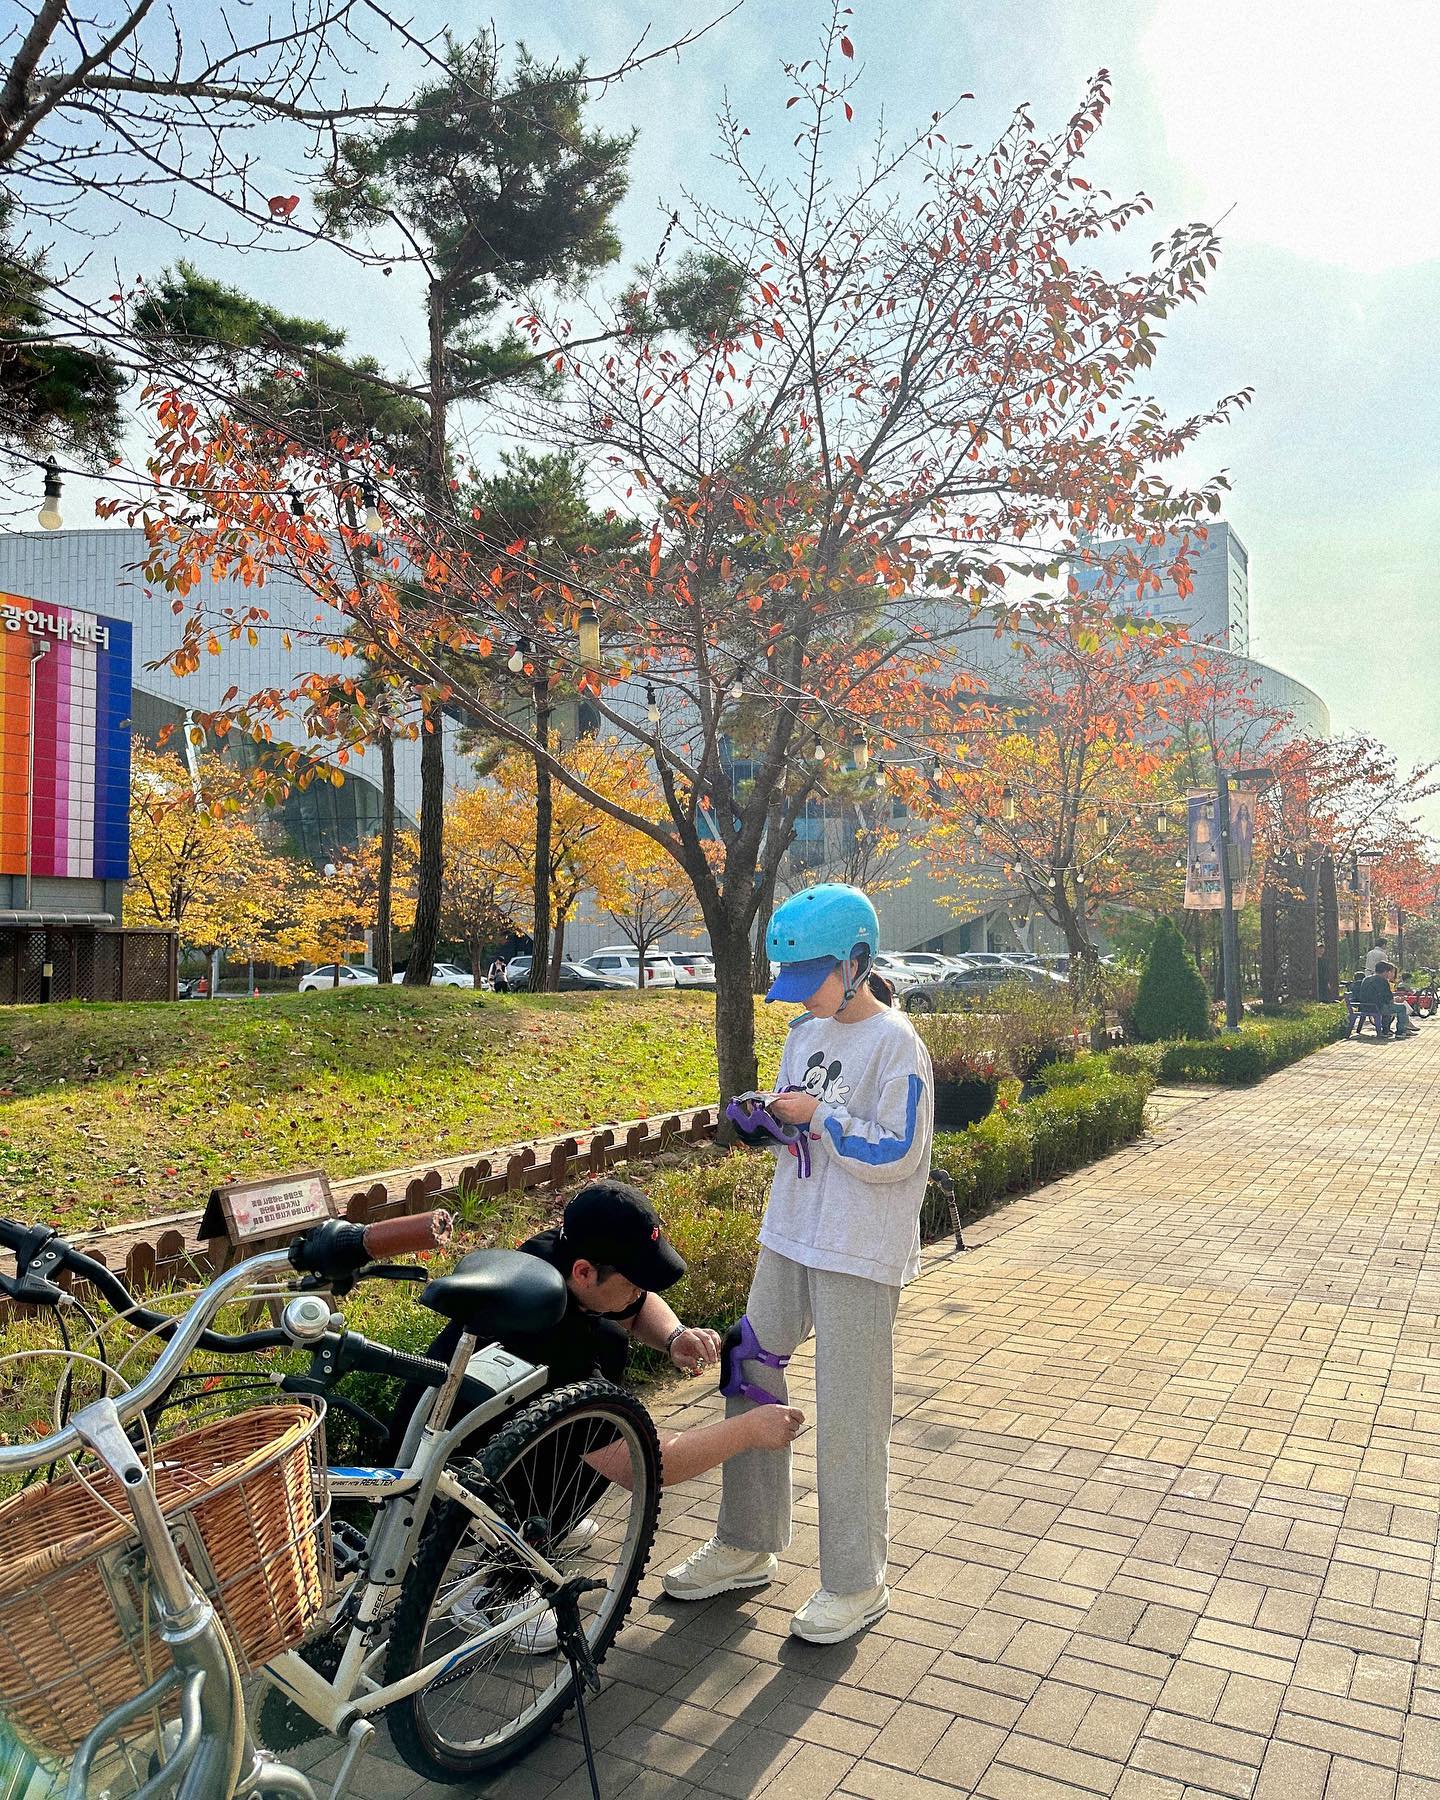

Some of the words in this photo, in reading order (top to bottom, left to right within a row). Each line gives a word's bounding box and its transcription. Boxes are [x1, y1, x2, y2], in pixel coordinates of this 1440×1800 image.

[0, 604, 109, 650] 광안내센터
[263, 1195, 284, 1206] 사랑하는
[283, 1190, 304, 1201] 마음으로
[291, 1206, 311, 1216] 바랍니다
